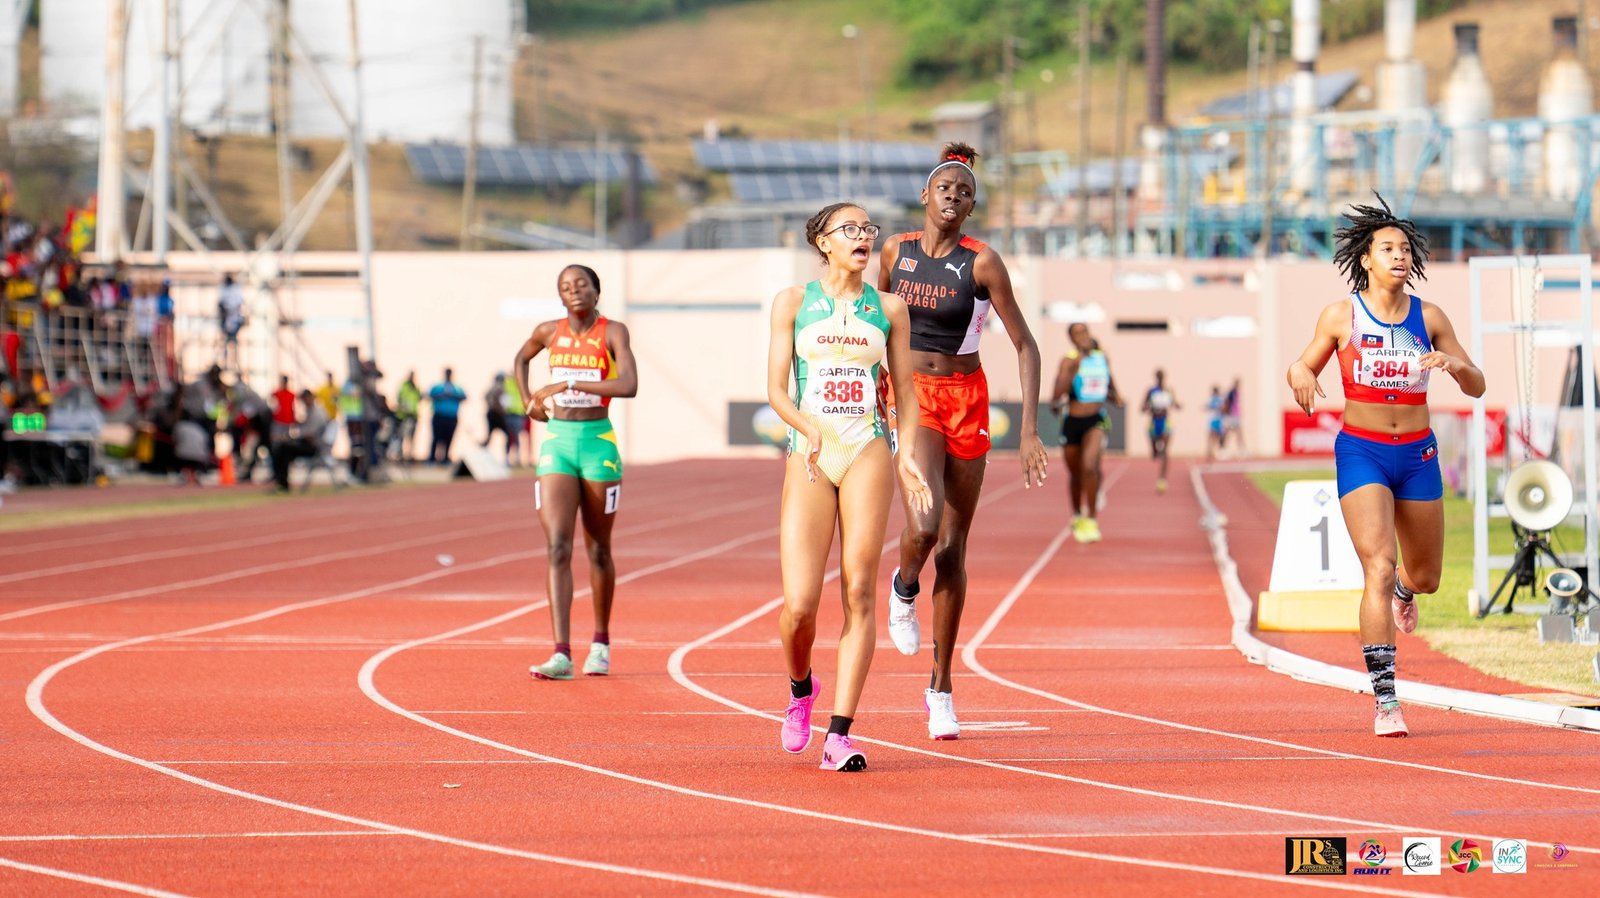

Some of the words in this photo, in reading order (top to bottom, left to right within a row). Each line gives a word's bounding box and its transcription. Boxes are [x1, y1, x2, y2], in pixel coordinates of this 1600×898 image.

[817, 335, 869, 346] GUYANA
[1367, 349, 1416, 358] CARIFTA
[549, 353, 606, 369] GRENADA
[819, 368, 867, 378] CARIFTA
[1373, 360, 1409, 378] 364
[1370, 380, 1409, 388] GAMES
[824, 381, 863, 402] 336
[822, 406, 865, 414] GAMES
[609, 488, 617, 510] 1
[1310, 516, 1330, 571] 1
